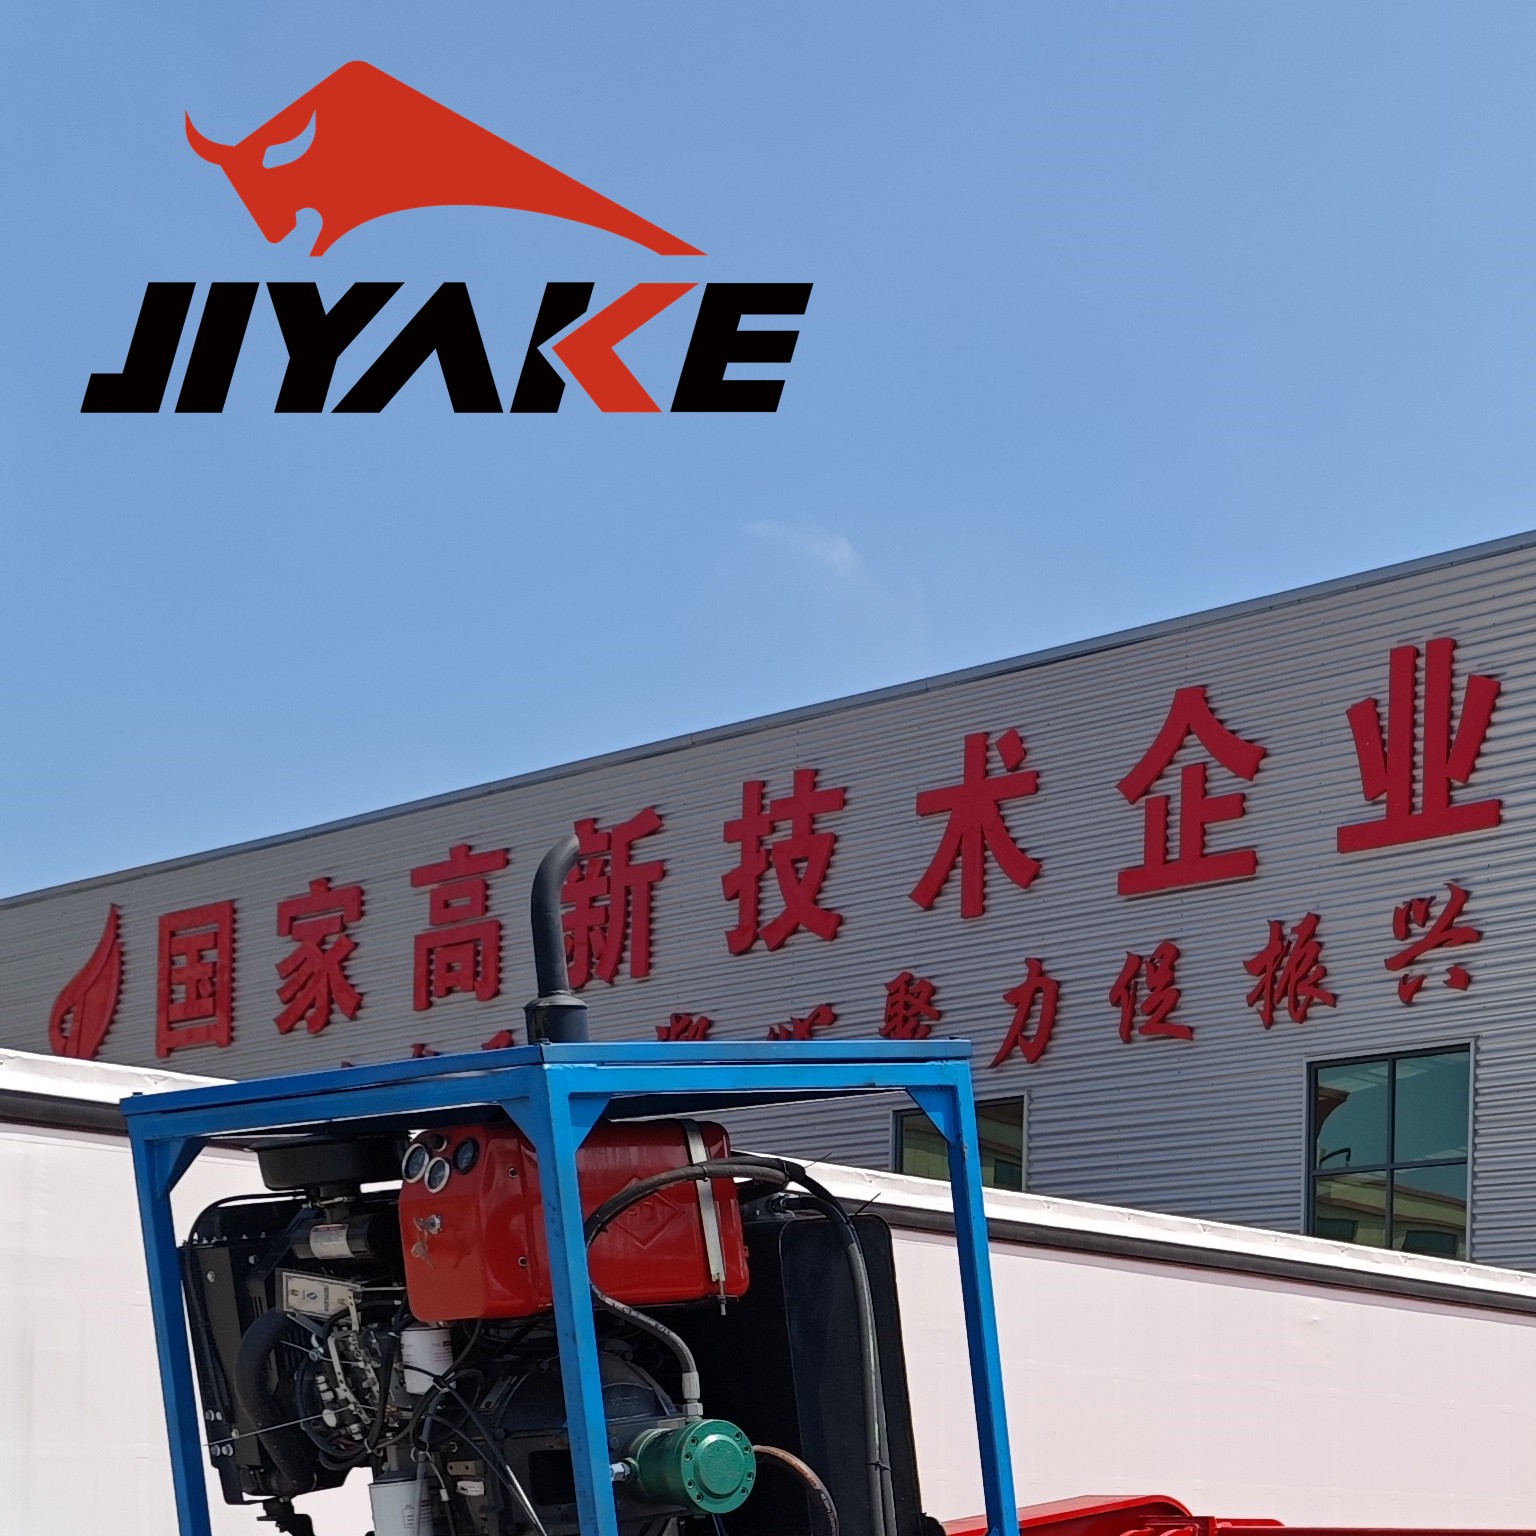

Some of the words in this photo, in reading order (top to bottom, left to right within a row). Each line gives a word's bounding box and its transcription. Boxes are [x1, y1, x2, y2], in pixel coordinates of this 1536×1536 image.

[156, 637, 1502, 1058] 国家高新技术企业
